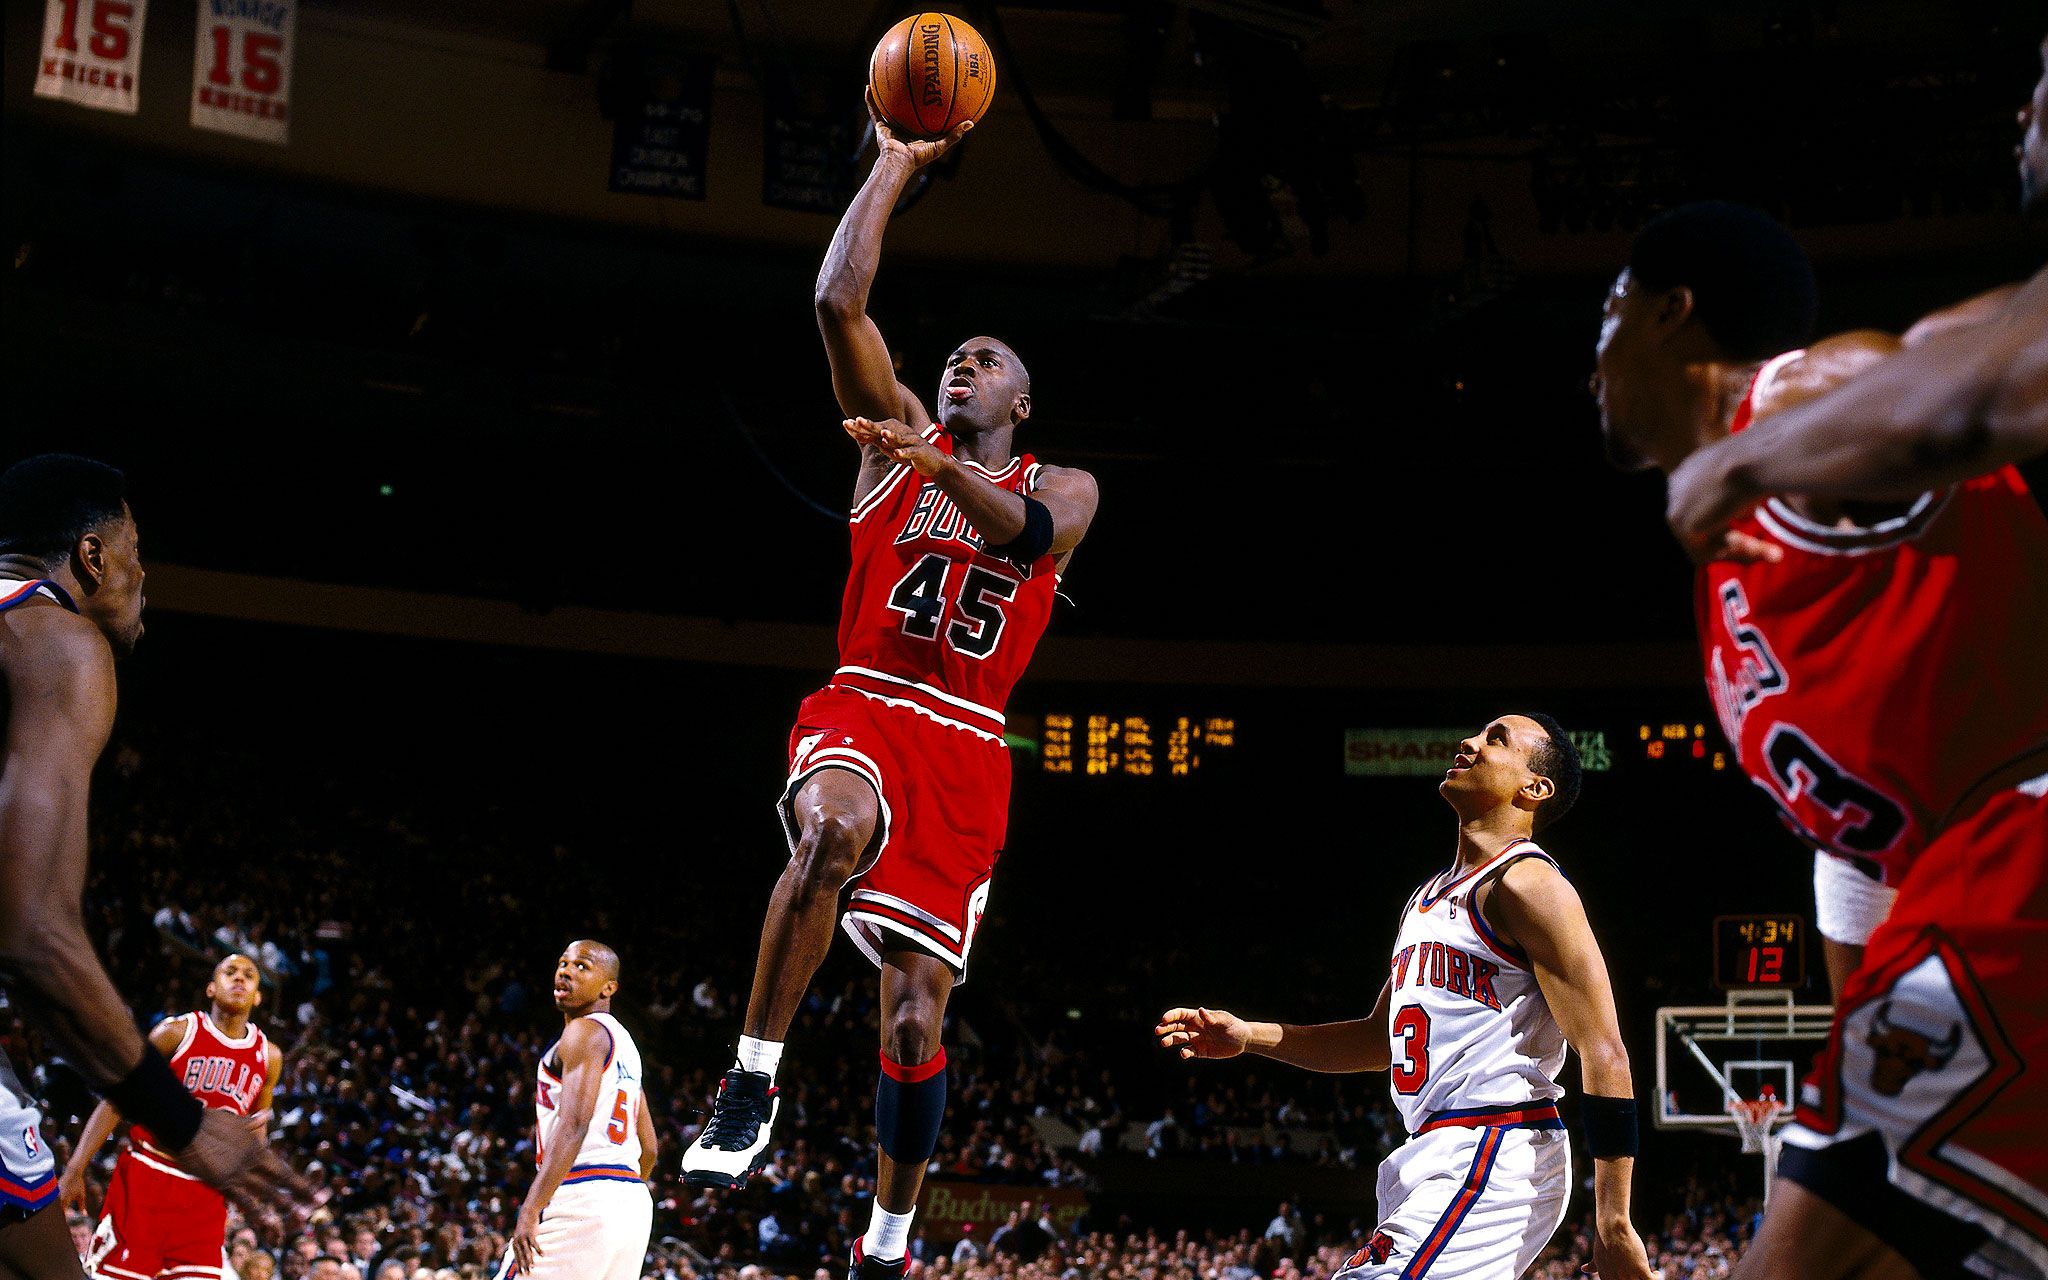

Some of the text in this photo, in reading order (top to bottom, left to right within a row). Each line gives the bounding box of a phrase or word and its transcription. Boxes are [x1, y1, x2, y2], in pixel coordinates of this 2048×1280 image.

[56, 0, 133, 60] 15
[208, 25, 284, 94] 15
[921, 22, 943, 106] SPALDING
[969, 53, 979, 78] NBA
[886, 552, 1020, 660] 45
[1739, 919, 1795, 944] 4:34
[1747, 947, 1784, 983] 12
[1416, 941, 1502, 1013] YORK
[1393, 1003, 1432, 1097] 3
